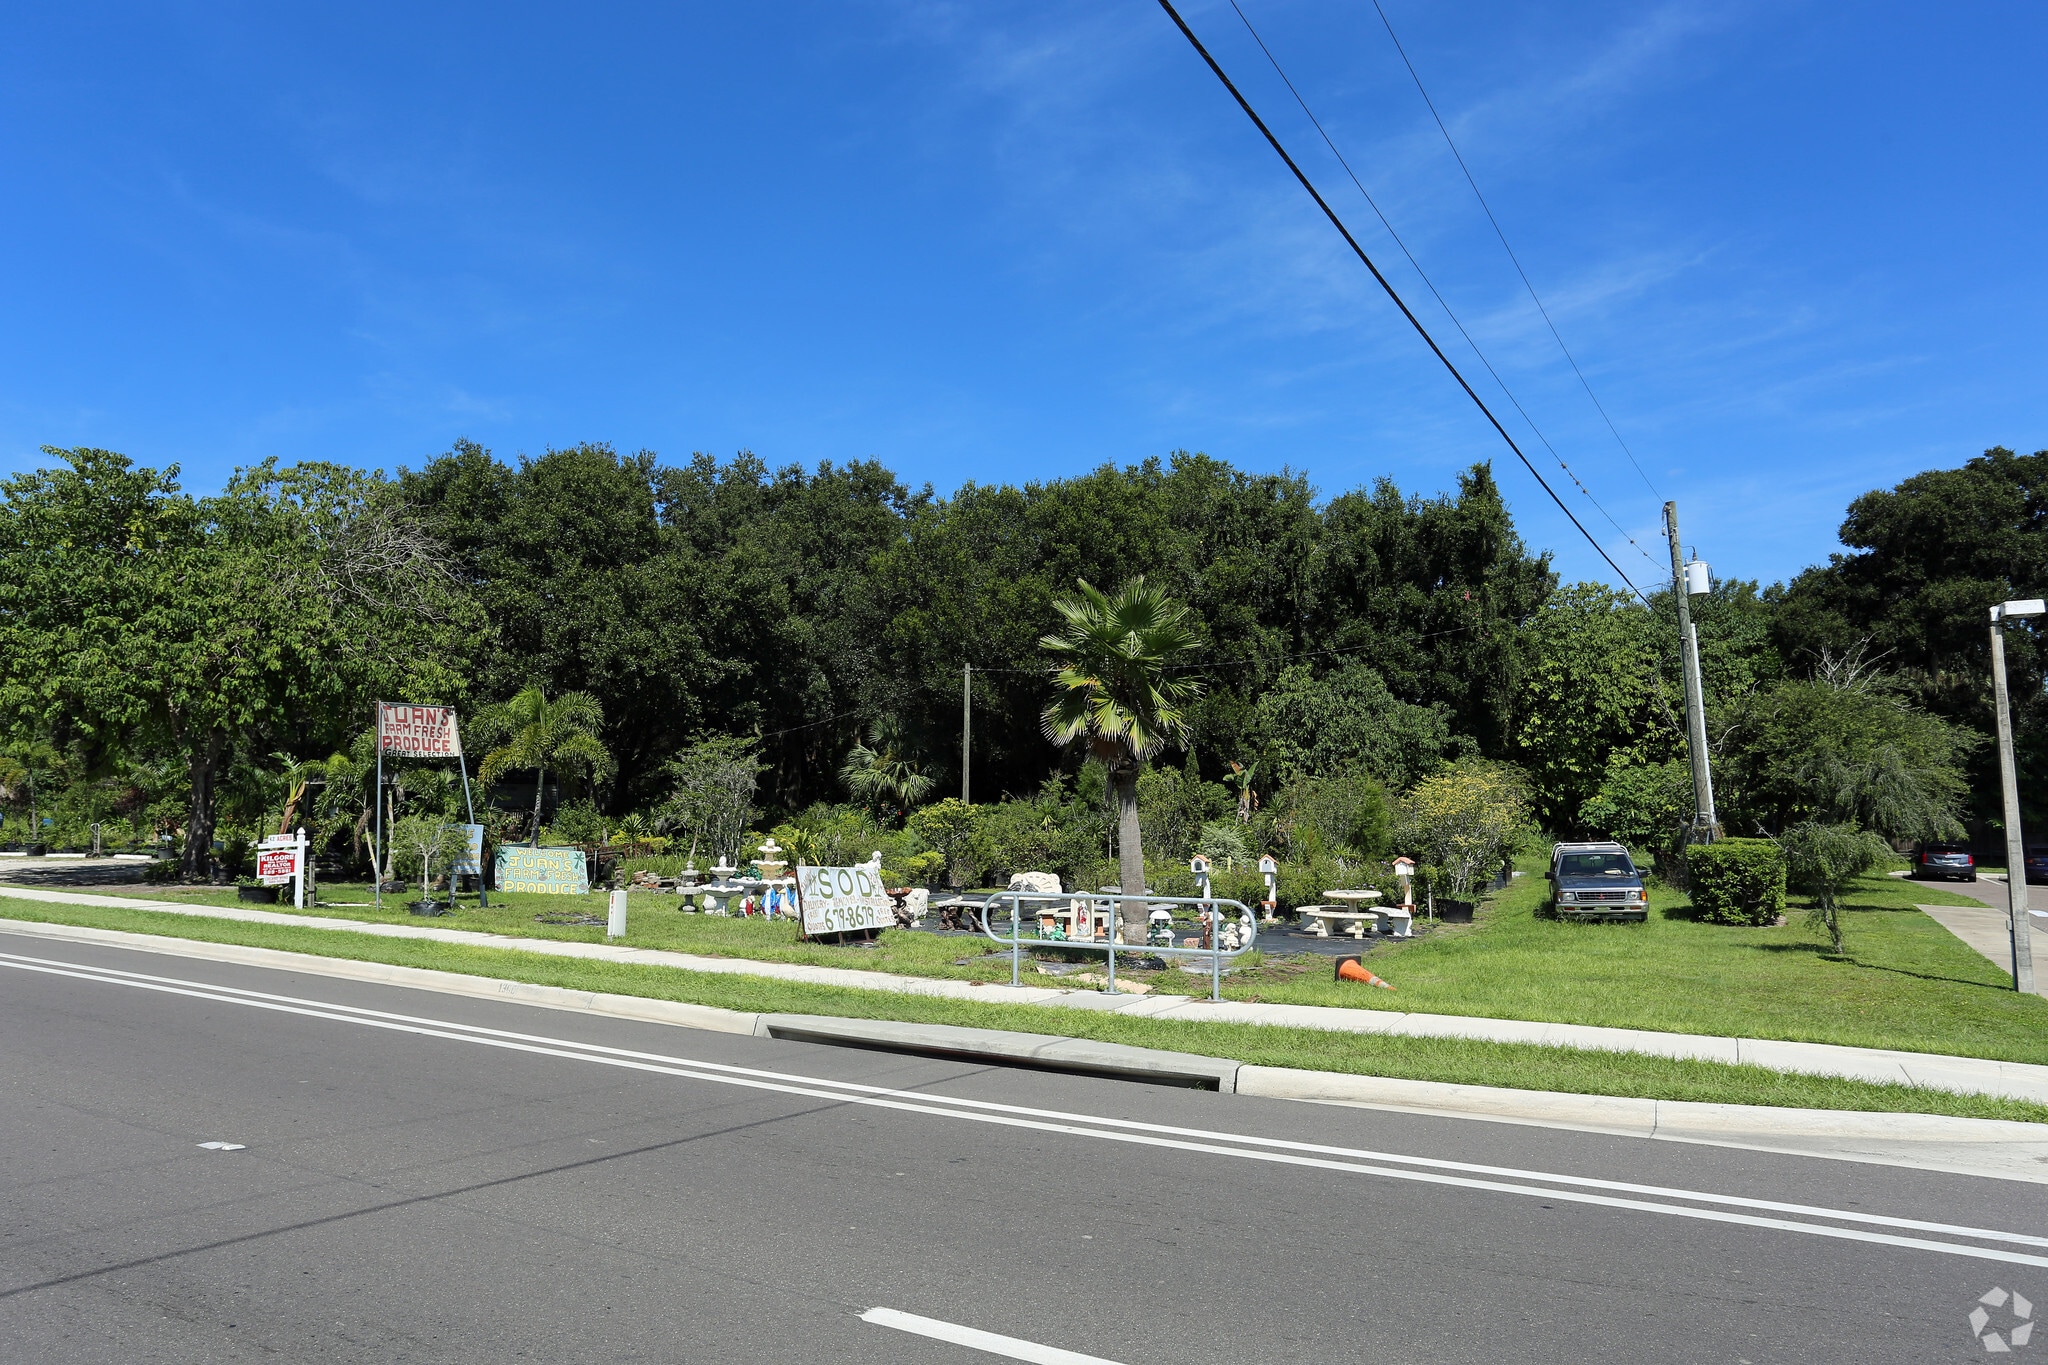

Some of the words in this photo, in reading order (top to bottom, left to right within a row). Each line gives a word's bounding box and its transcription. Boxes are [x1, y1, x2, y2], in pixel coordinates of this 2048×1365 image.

[384, 723, 410, 735] FARM
[414, 725, 450, 738] FRESH
[383, 736, 450, 752] PRODUCE
[385, 749, 410, 757] GREAT
[261, 854, 294, 862] KILGORE
[516, 849, 569, 858] WELCOME
[509, 856, 572, 870] JUAN'S
[505, 868, 539, 880] FARM
[546, 870, 579, 881] FRESH
[503, 880, 578, 894] PRODUCE
[818, 868, 872, 899] SOD
[825, 905, 874, 930] 679-8679
